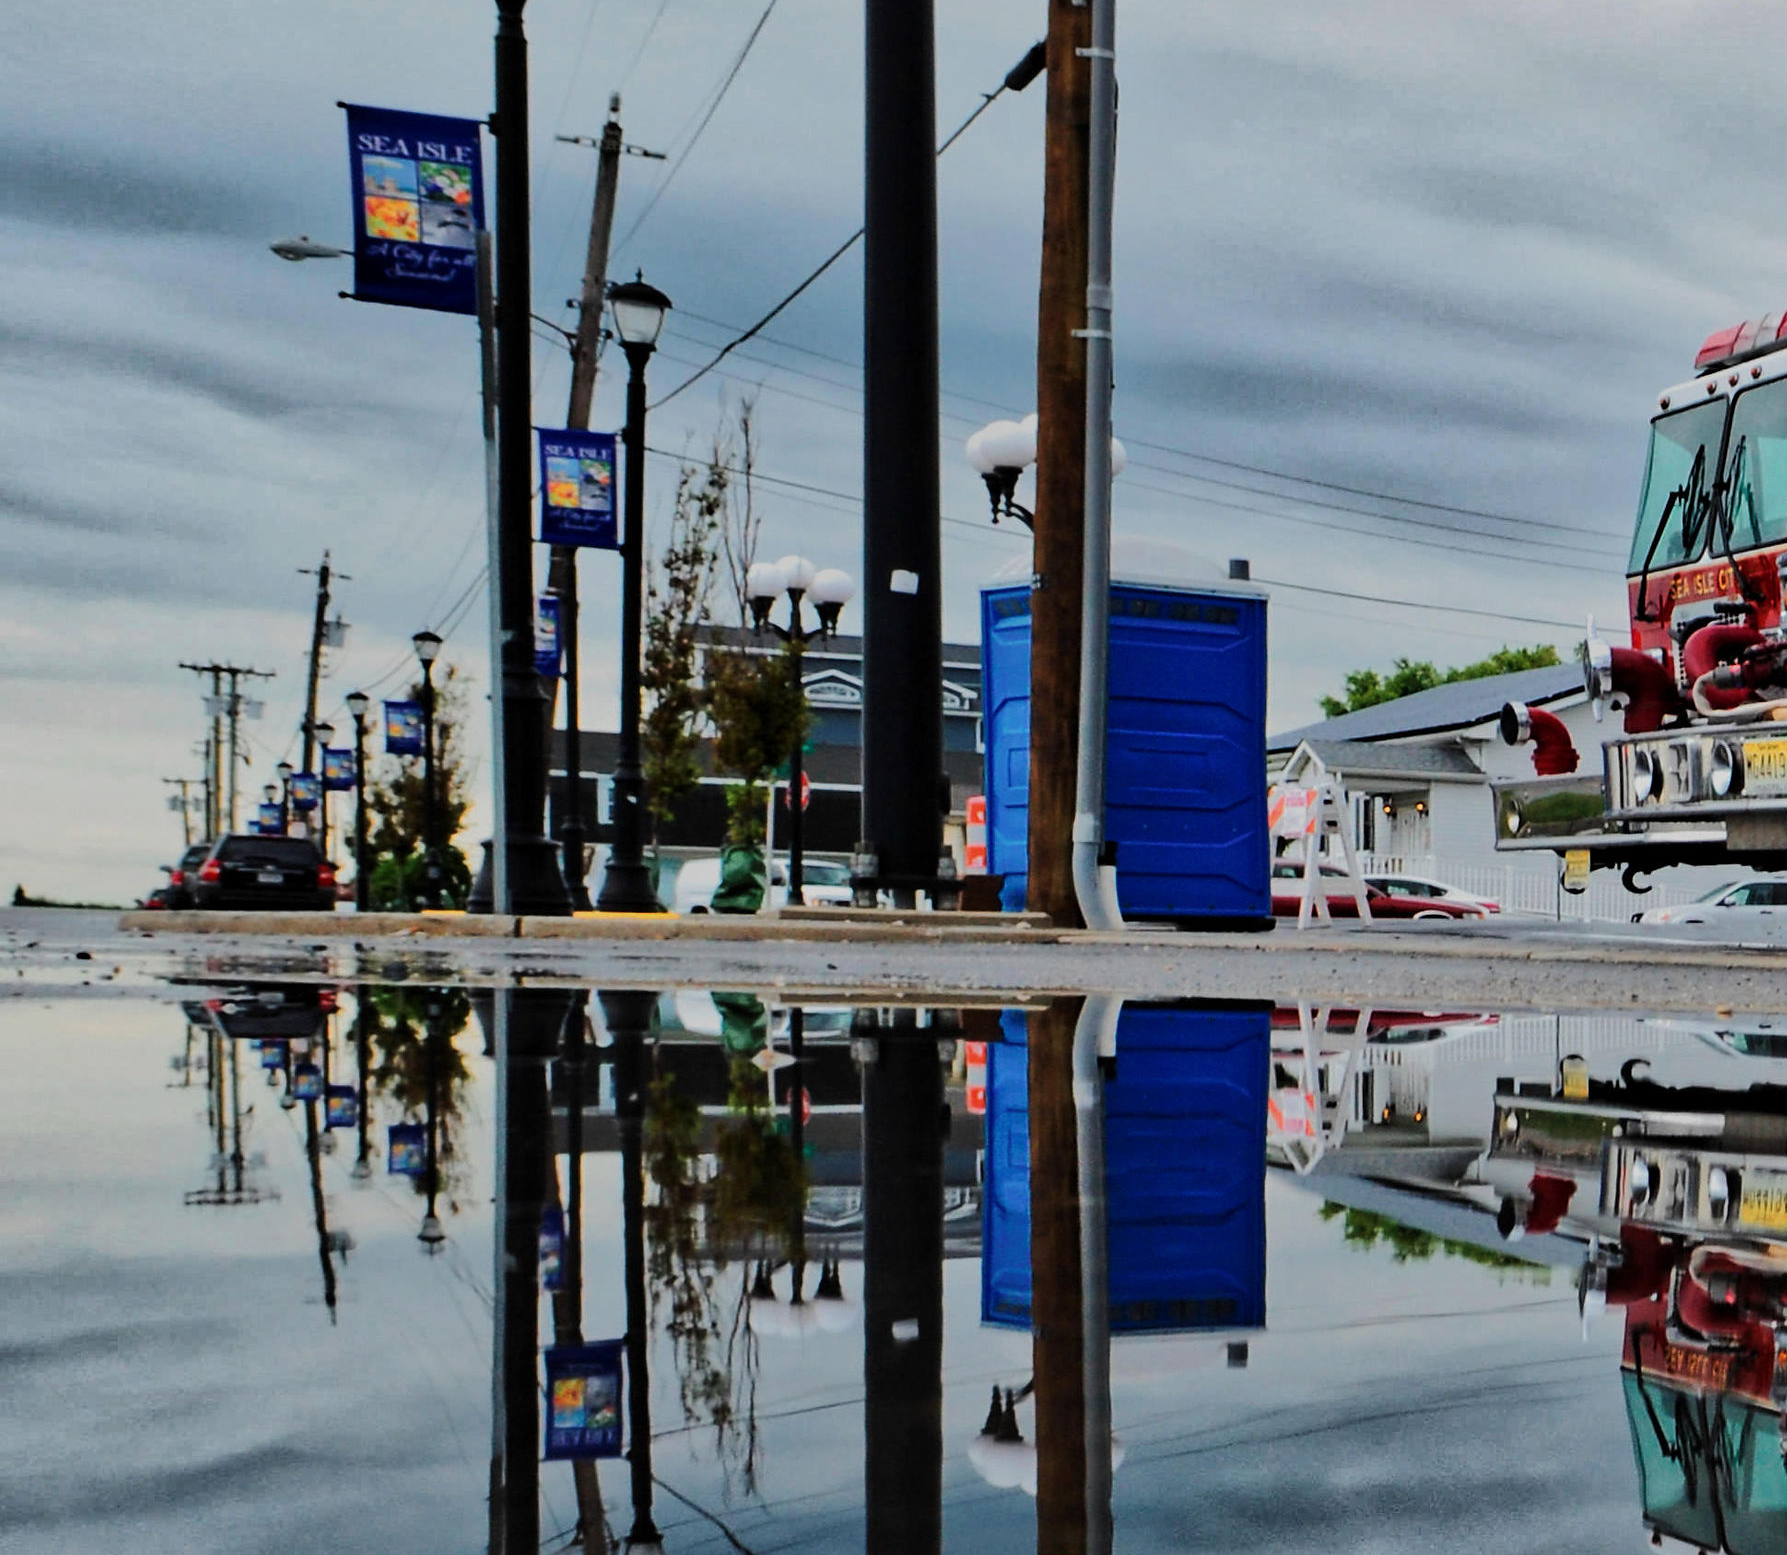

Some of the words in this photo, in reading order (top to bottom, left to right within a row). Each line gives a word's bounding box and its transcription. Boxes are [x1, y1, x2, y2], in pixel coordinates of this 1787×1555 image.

[357, 133, 411, 157] SEA
[417, 140, 473, 164] ISLE
[1670, 577, 1690, 600] SEA
[1692, 571, 1716, 595] ISLE
